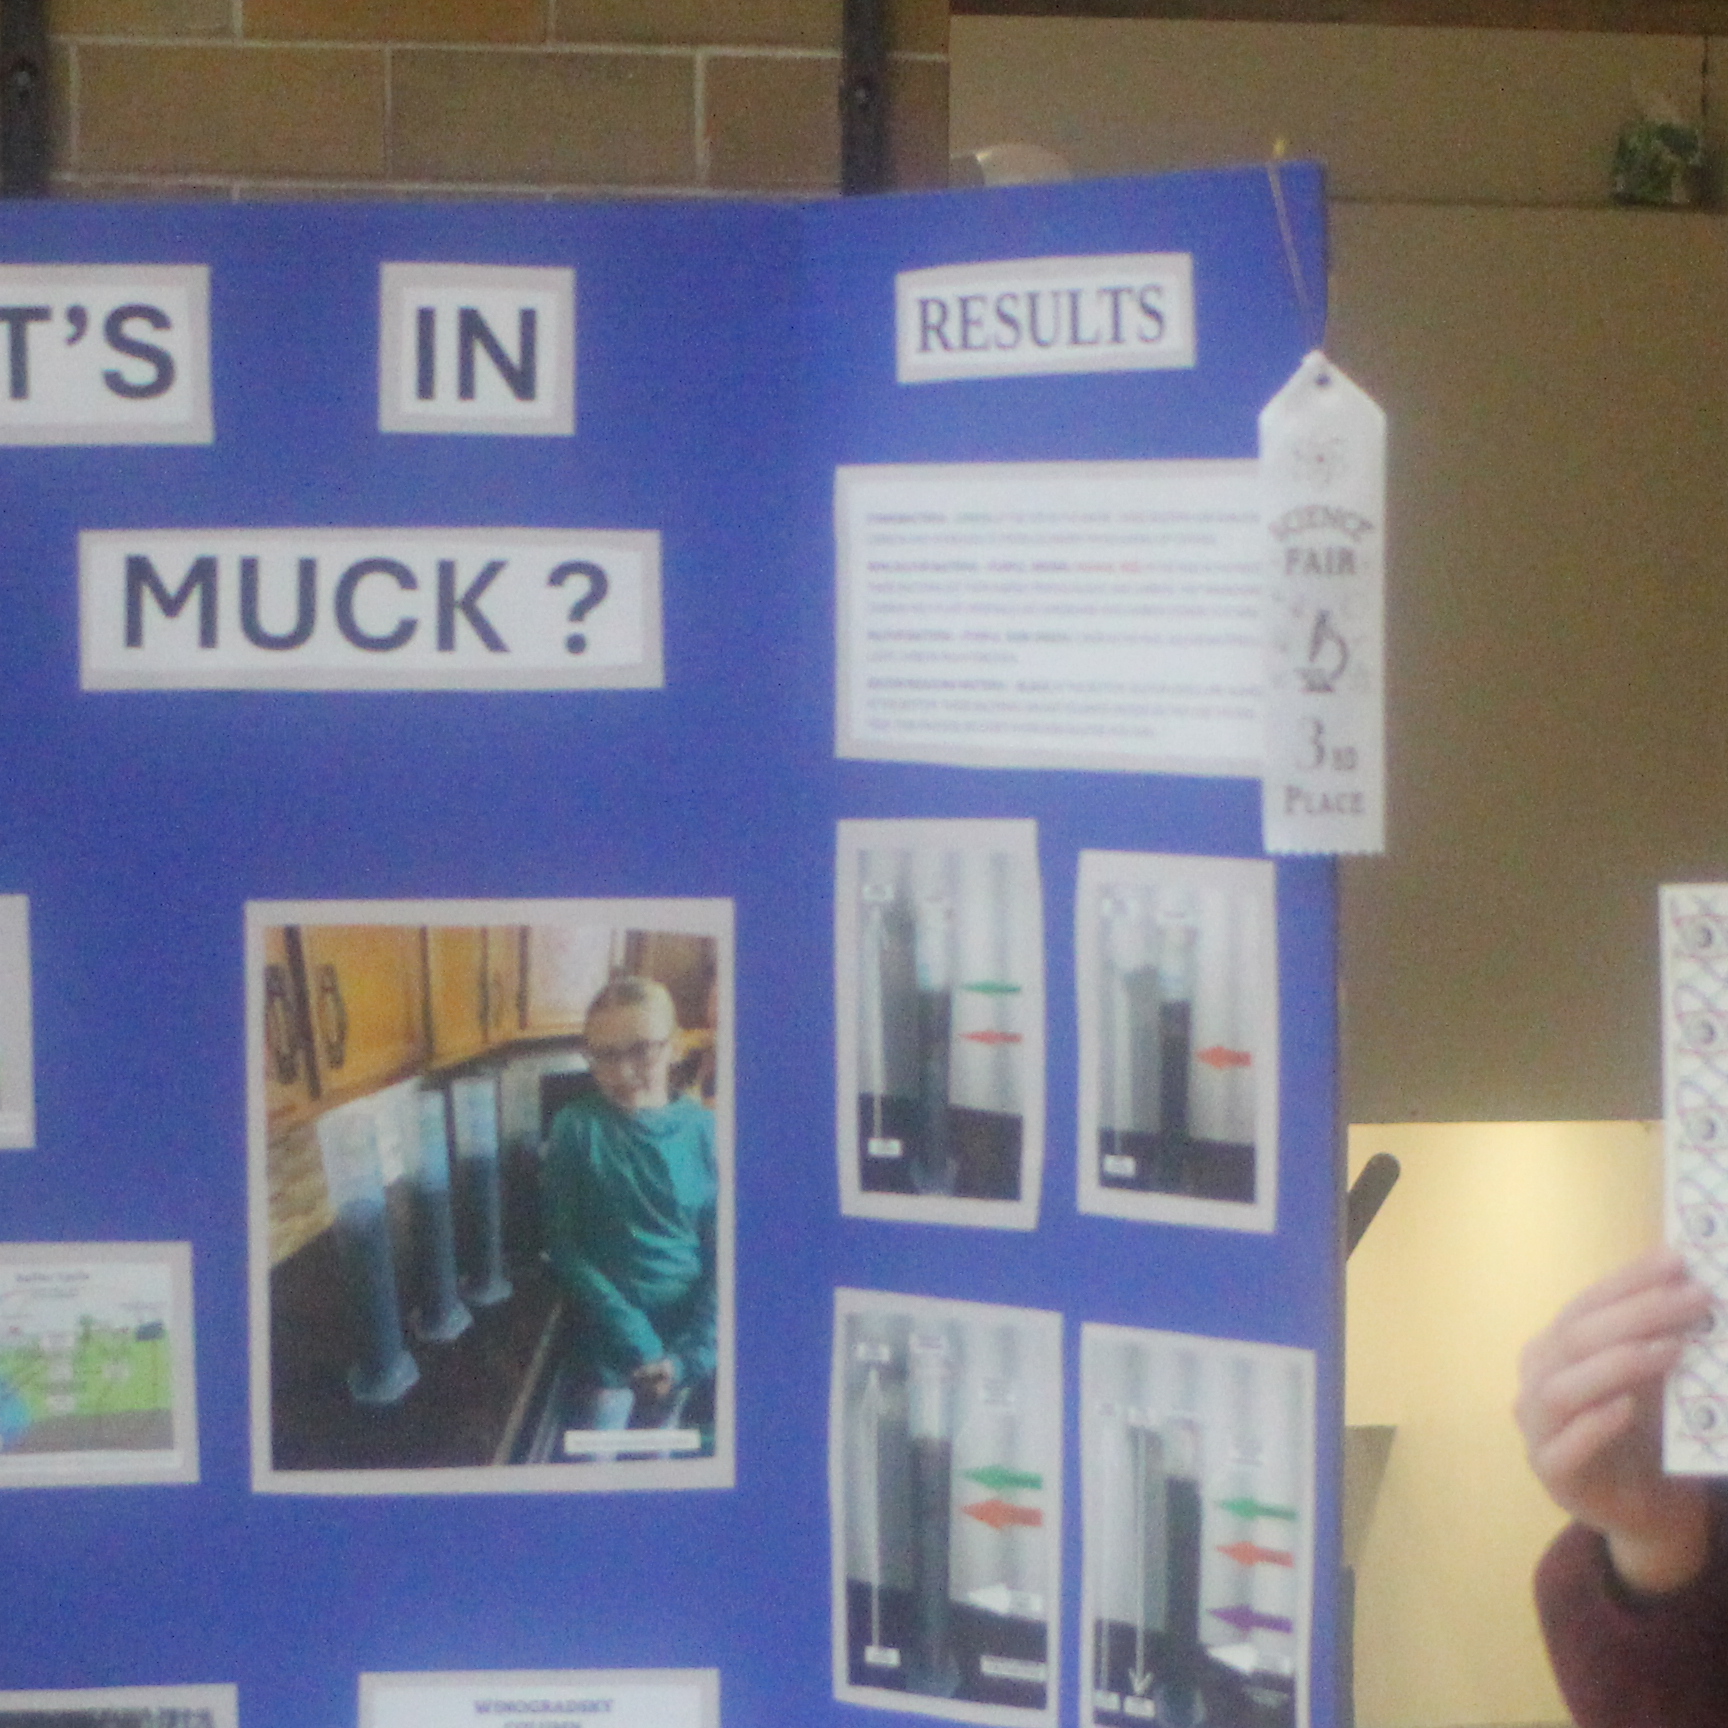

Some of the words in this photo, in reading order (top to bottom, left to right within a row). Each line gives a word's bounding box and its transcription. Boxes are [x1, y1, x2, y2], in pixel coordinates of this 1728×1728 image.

[414, 305, 538, 402] IN
[917, 283, 1167, 354] RESULTS
[1284, 546, 1357, 577] FAIR
